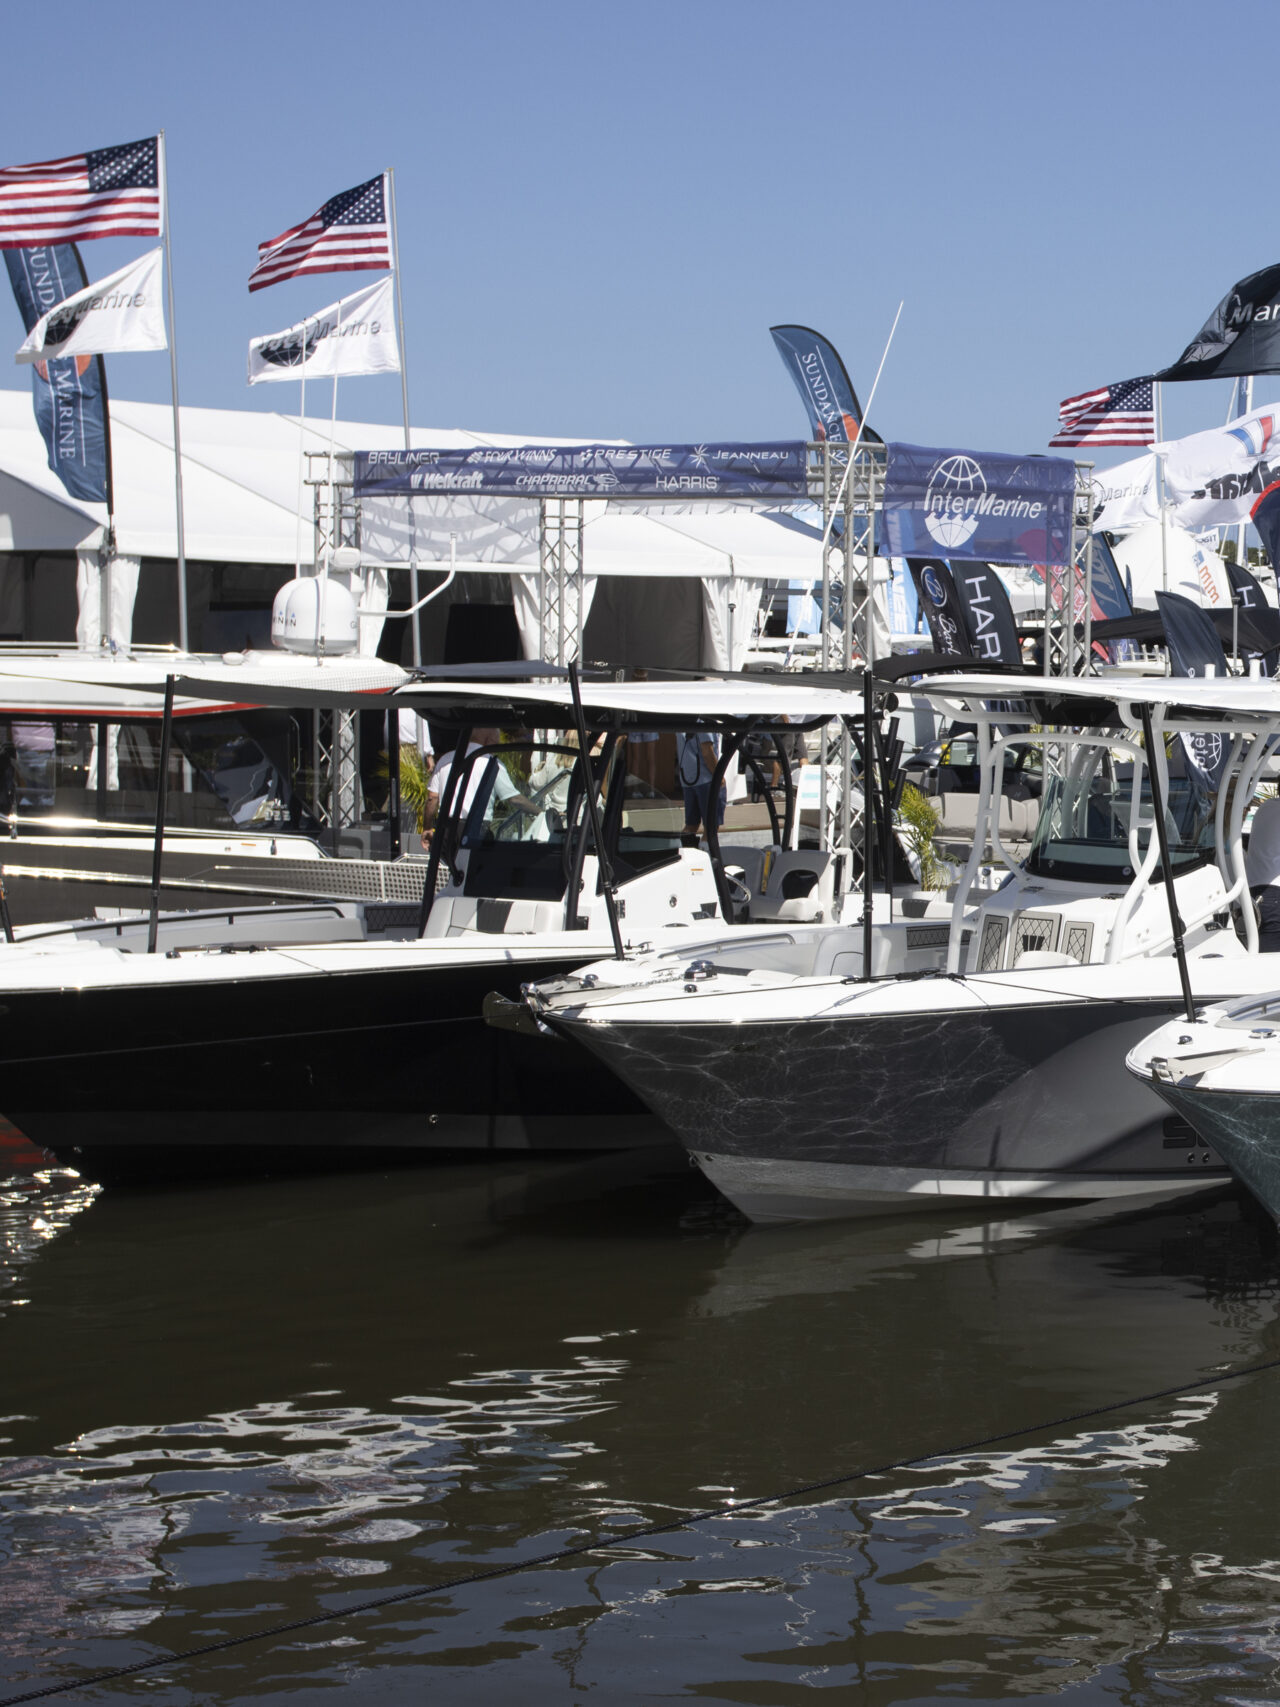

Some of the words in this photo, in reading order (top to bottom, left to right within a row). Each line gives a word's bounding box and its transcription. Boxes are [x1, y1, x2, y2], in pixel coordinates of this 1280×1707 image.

[802, 352, 842, 442] SUNDANCE
[55, 369, 76, 459] MARINE
[368, 452, 439, 465] BAYLINER
[514, 449, 557, 462] WINNS
[594, 449, 672, 461] PRESTIGE
[712, 450, 789, 460] JEANNEAU
[424, 471, 483, 490] Wellcraft
[656, 476, 717, 489] HARRIS
[965, 576, 1002, 659] HAR
[939, 613, 962, 655] Barl
